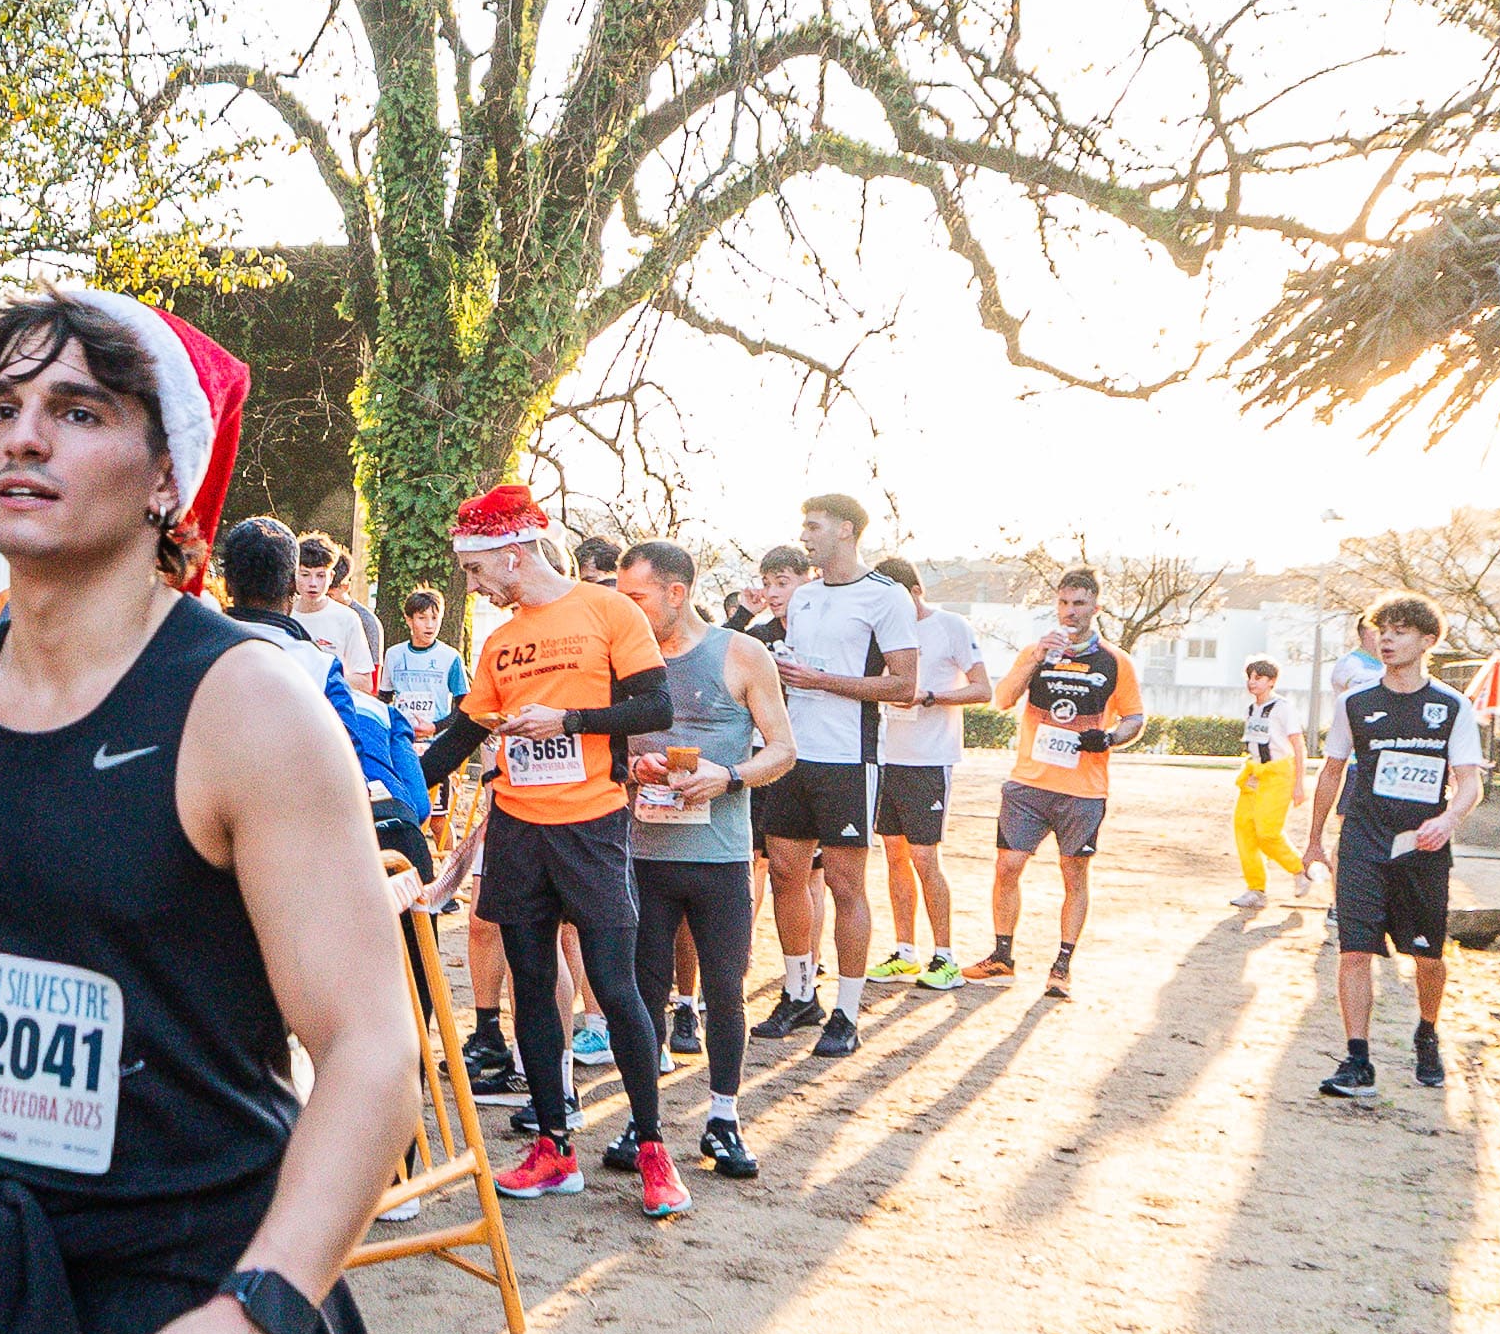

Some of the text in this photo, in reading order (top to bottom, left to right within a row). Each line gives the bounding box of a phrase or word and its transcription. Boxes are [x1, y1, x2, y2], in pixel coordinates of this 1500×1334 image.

[496, 643, 536, 671] C42
[409, 700, 434, 712] 4627
[532, 736, 577, 761] 5651
[1401, 766, 1439, 785] 2725
[5, 968, 112, 1022] SILVESTRE
[62, 1097, 104, 1132] 2025
